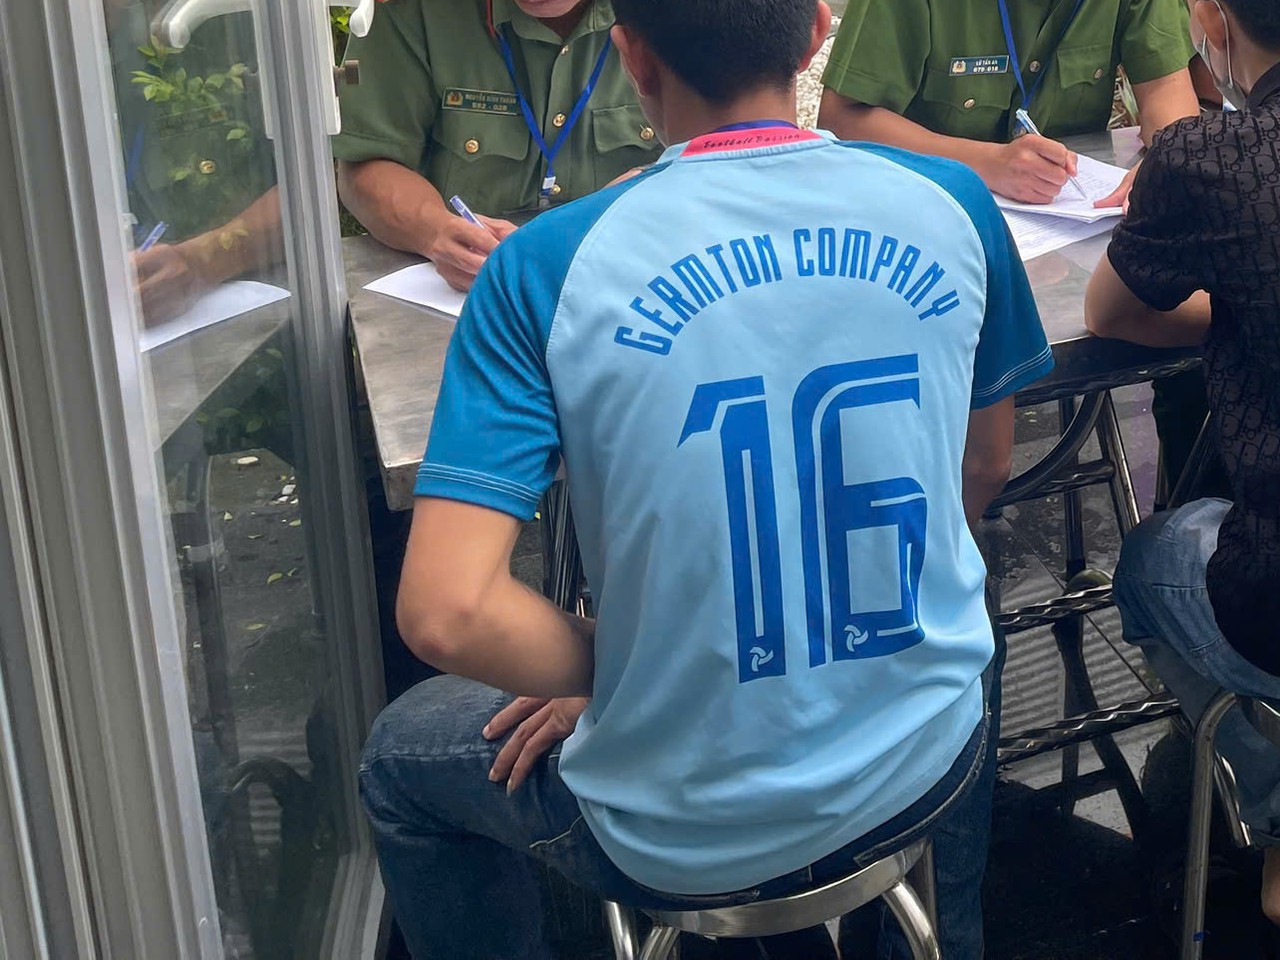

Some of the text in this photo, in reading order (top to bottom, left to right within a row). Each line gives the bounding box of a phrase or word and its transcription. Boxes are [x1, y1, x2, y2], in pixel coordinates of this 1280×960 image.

[614, 227, 961, 355] GERMTON COMPANY
[677, 353, 928, 684] 16
